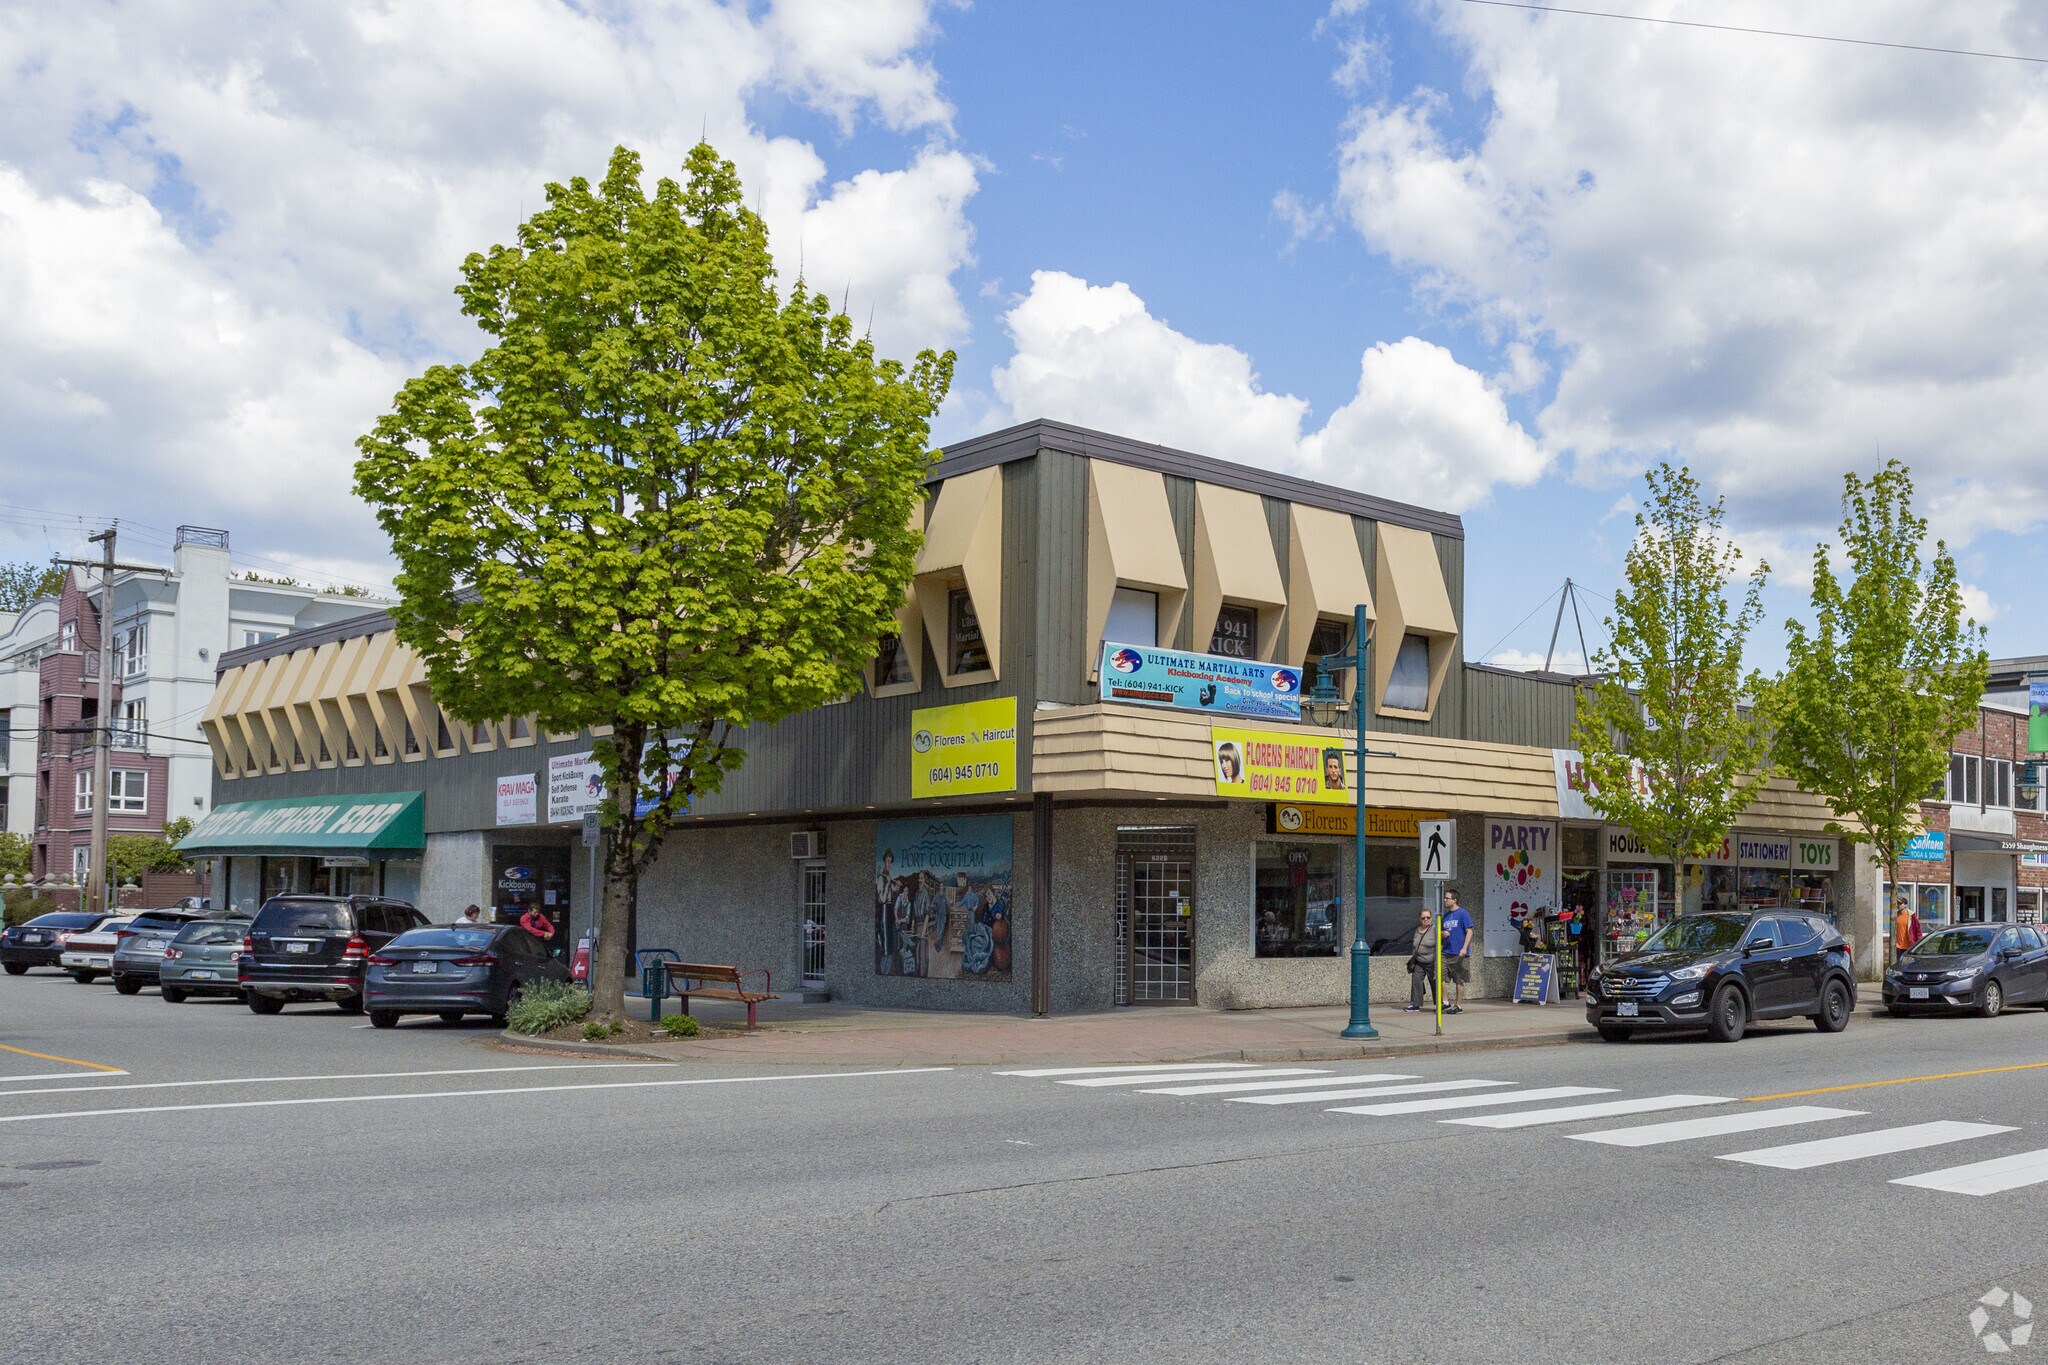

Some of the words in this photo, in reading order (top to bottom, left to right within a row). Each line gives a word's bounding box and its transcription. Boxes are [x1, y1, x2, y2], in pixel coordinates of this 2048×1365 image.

[1224, 620, 1247, 638] 941
[1147, 654, 1195, 670] ULTIMATE
[1199, 661, 1239, 676] MARTIAL
[1242, 667, 1265, 678] ARTS
[1108, 677, 1122, 687] Tel:
[1124, 680, 1146, 691] (604)
[1147, 683, 1184, 693] 941-KICK
[1167, 668, 1214, 682] Kickboxing
[1216, 674, 1252, 687] Academy
[1224, 685, 1241, 696] Back
[1252, 690, 1274, 699] school
[1275, 693, 1299, 702] special
[1225, 703, 1258, 712] Confidence
[934, 734, 966, 747] Florens
[983, 727, 1015, 742] Haircut
[551, 758, 574, 769] Ultimate
[1246, 741, 1282, 768] FLORENS
[1284, 745, 1320, 771] HAIRCUT
[551, 773, 562, 783] Sport
[929, 767, 953, 785] (604)
[955, 765, 973, 780] 945
[975, 762, 999, 778] 0710
[499, 783, 515, 796] KRAV
[515, 781, 535, 795] MAGA
[551, 785, 560, 794] Self
[1250, 772, 1273, 793] (604)
[1274, 775, 1291, 793] 945
[1295, 777, 1317, 794] 0710
[551, 795, 569, 804] Karate
[242, 806, 341, 835] NATURAL
[325, 803, 403, 835] FOOD
[1304, 809, 1348, 831] Florens
[1369, 813, 1419, 834] Haircut's
[1491, 824, 1551, 851] PARTY
[1910, 833, 1944, 850] Sadhana
[2002, 841, 2016, 849] 2559
[901, 849, 926, 867] PORT
[929, 851, 984, 869] COQUITLAM
[1289, 851, 1308, 862] OPEN
[1740, 841, 1789, 861] STATIONERY
[1799, 843, 1831, 865] TOYS
[1911, 850, 1924, 858] YOGA
[1929, 852, 1944, 860] SOUND
[498, 879, 536, 891] Kickboxing
